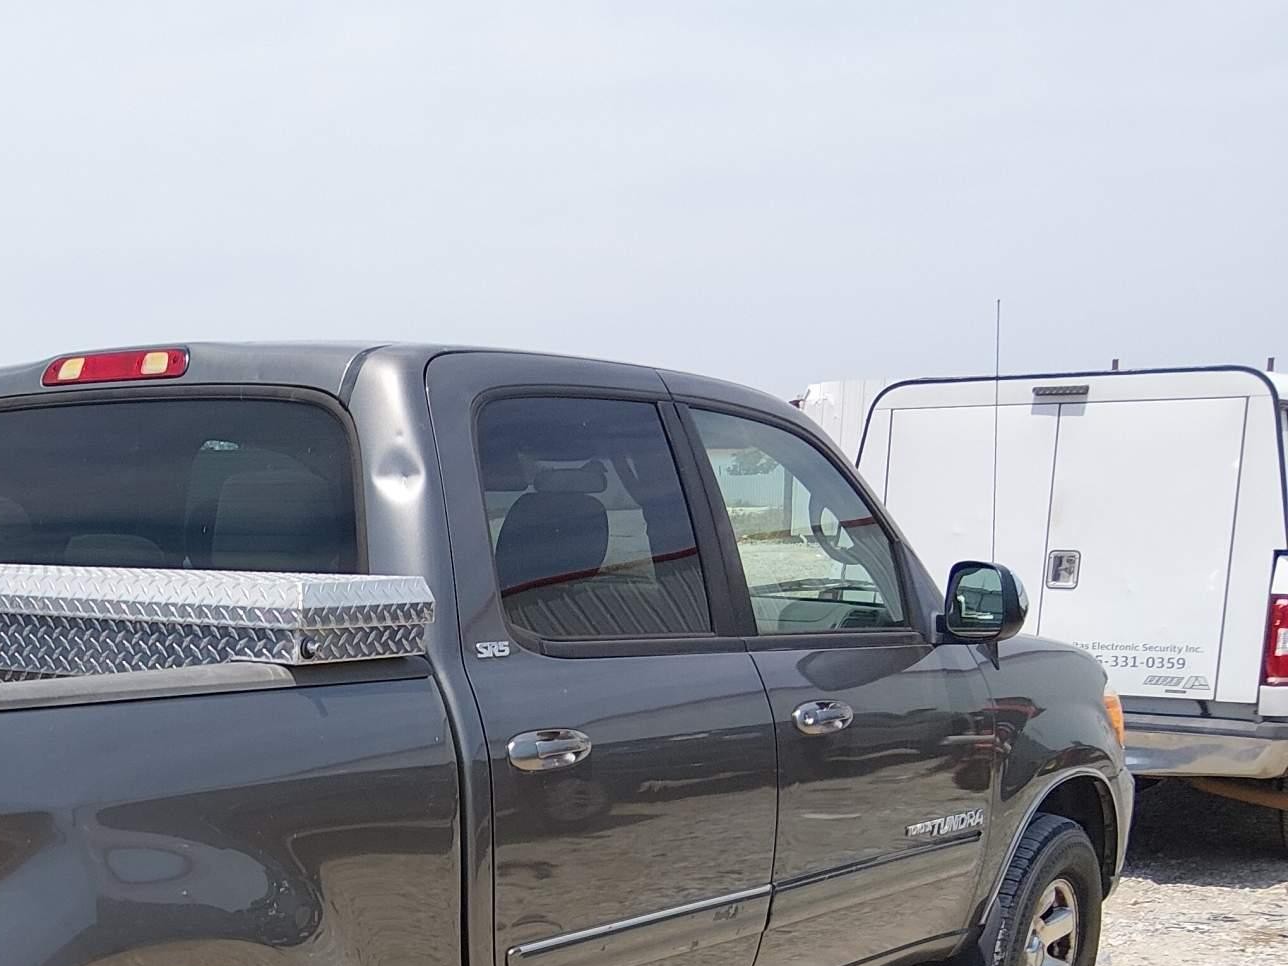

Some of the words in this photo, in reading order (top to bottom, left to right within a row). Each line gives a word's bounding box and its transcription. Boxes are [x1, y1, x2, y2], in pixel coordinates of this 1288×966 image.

[476, 641, 510, 658] SR5
[1091, 641, 1139, 652] Electronic
[1142, 643, 1182, 655] Security
[1185, 644, 1205, 654] Inc.
[930, 809, 984, 836] TUNDRA
